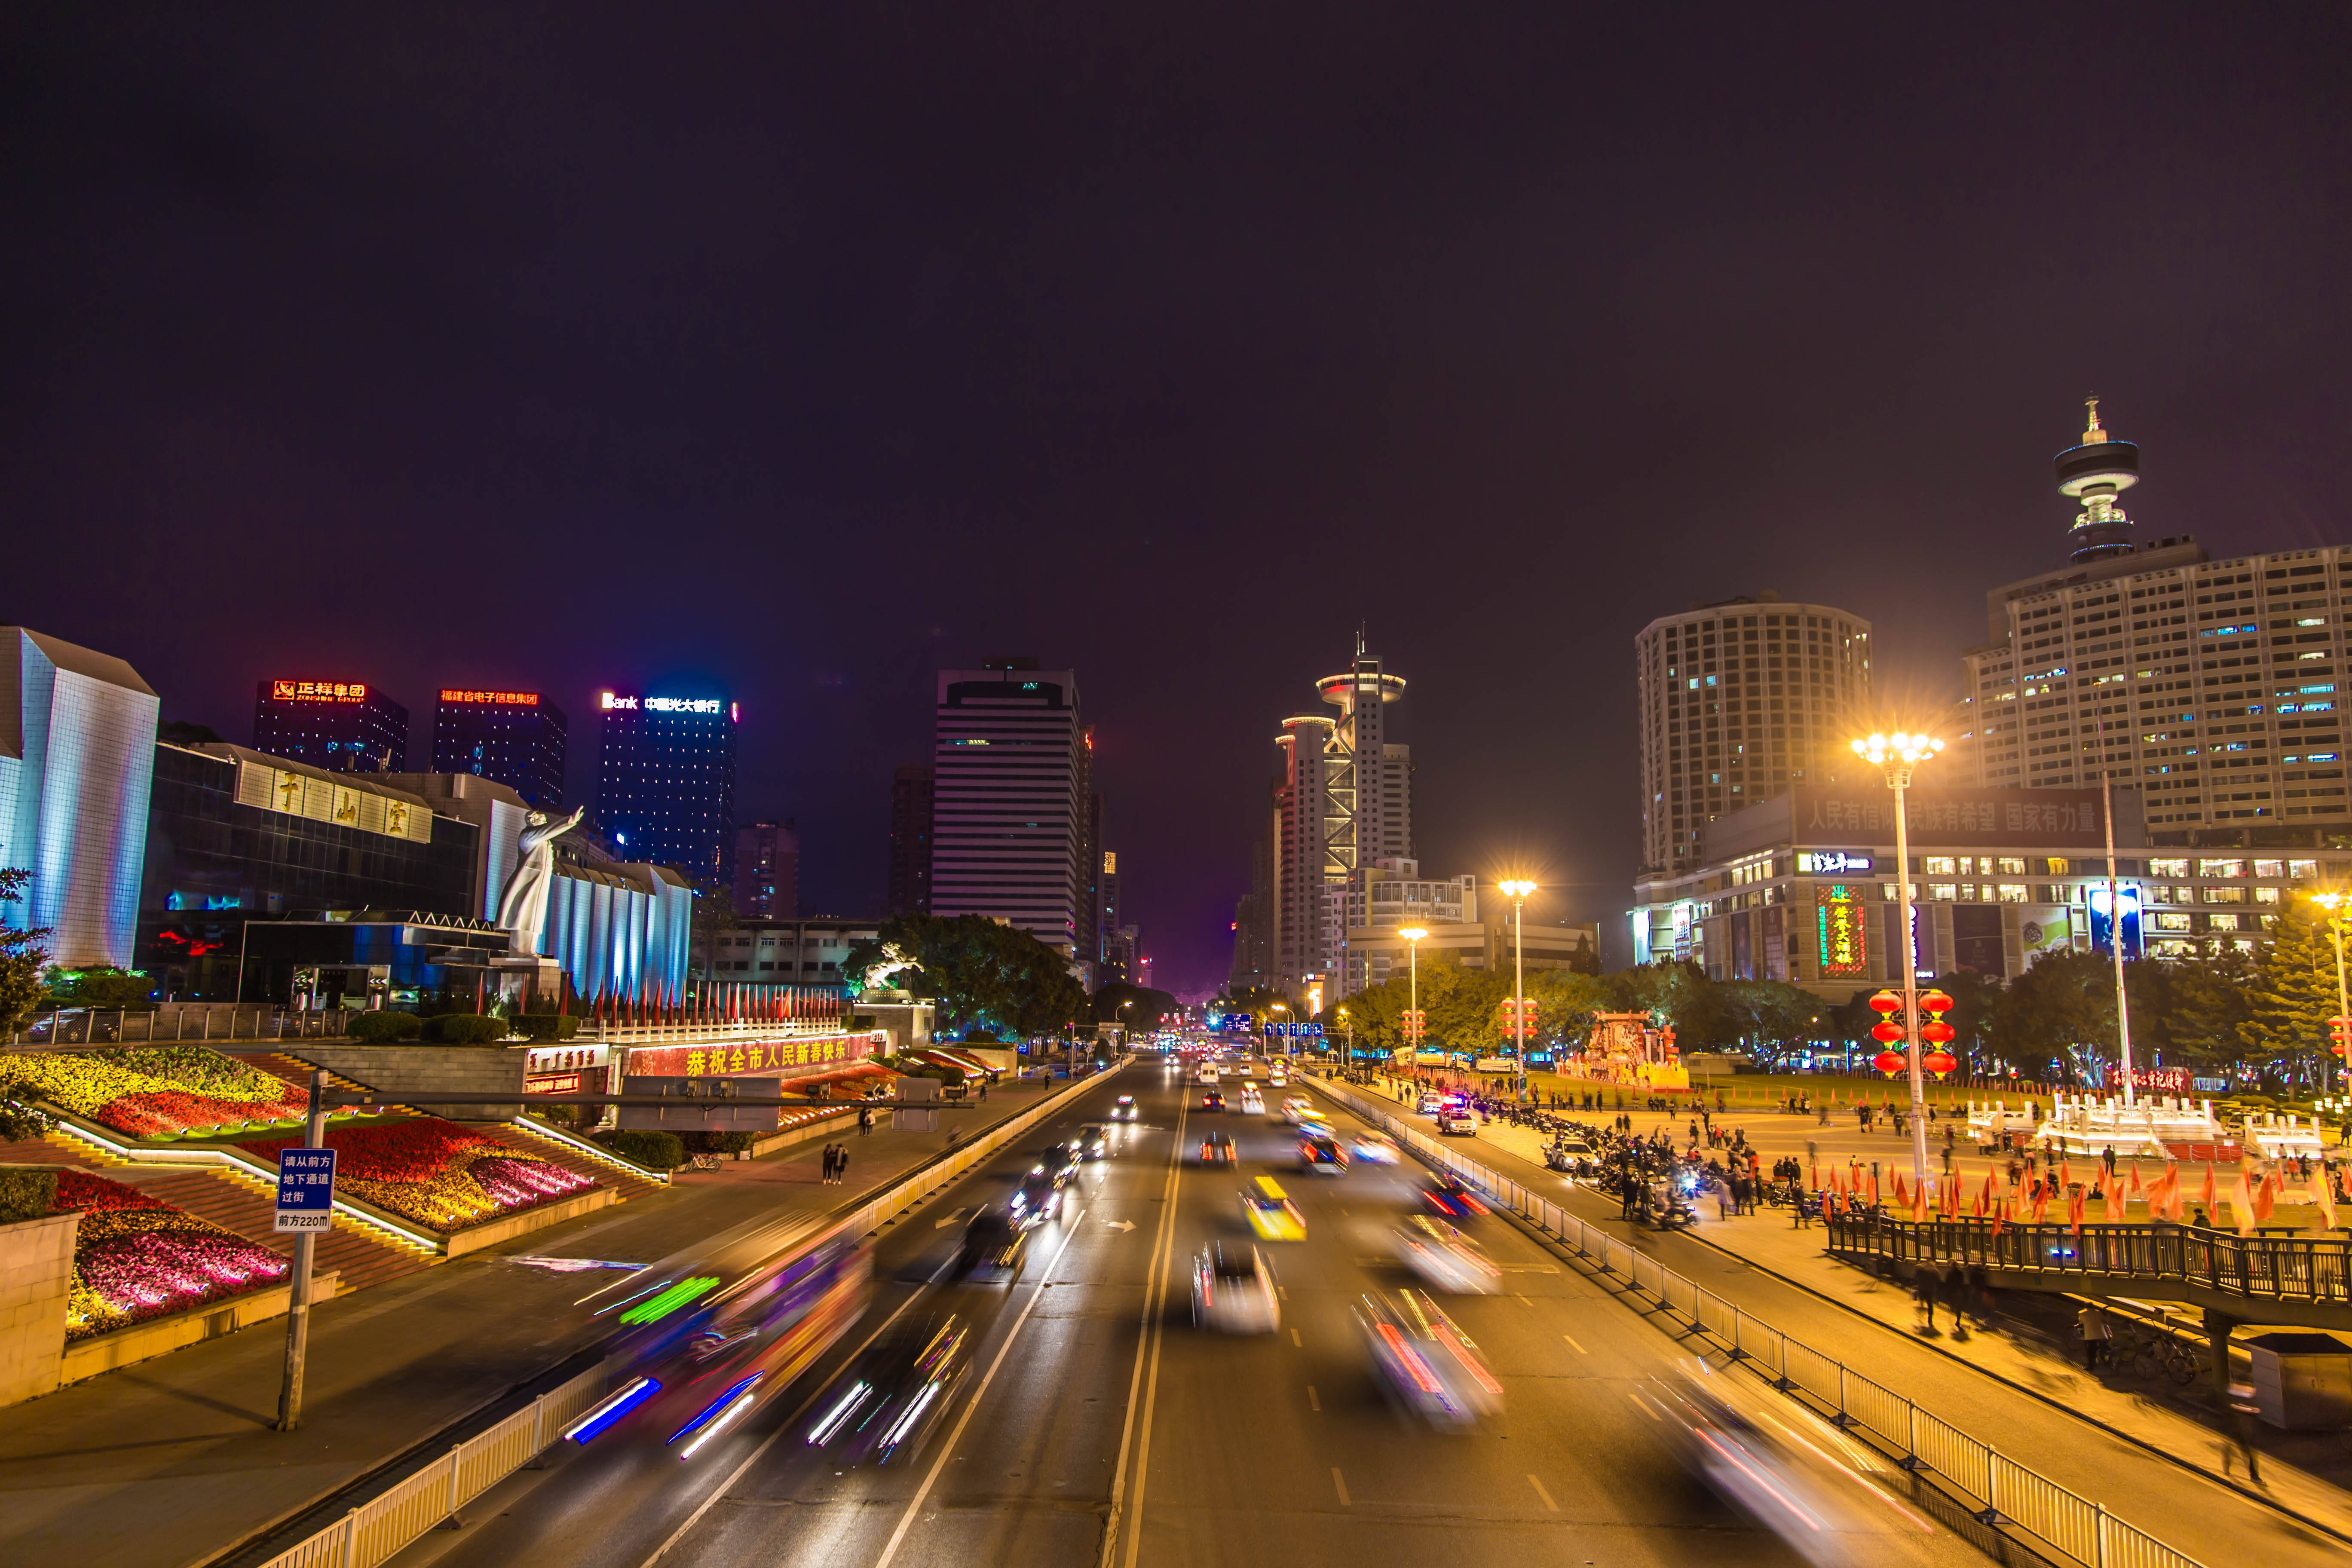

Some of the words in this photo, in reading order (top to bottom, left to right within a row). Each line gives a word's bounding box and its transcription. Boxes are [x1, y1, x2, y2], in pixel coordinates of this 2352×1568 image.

[297, 683, 364, 697] 正祥集团
[441, 690, 538, 705] 福建省电子信息集团
[602, 693, 638, 709] Bank
[1908, 801, 1997, 832] 民族有希望
[2005, 801, 2097, 833] 国家有力量
[285, 1156, 331, 1167] 请从前方
[283, 1173, 329, 1185] 地下通道
[282, 1191, 304, 1203] 过街
